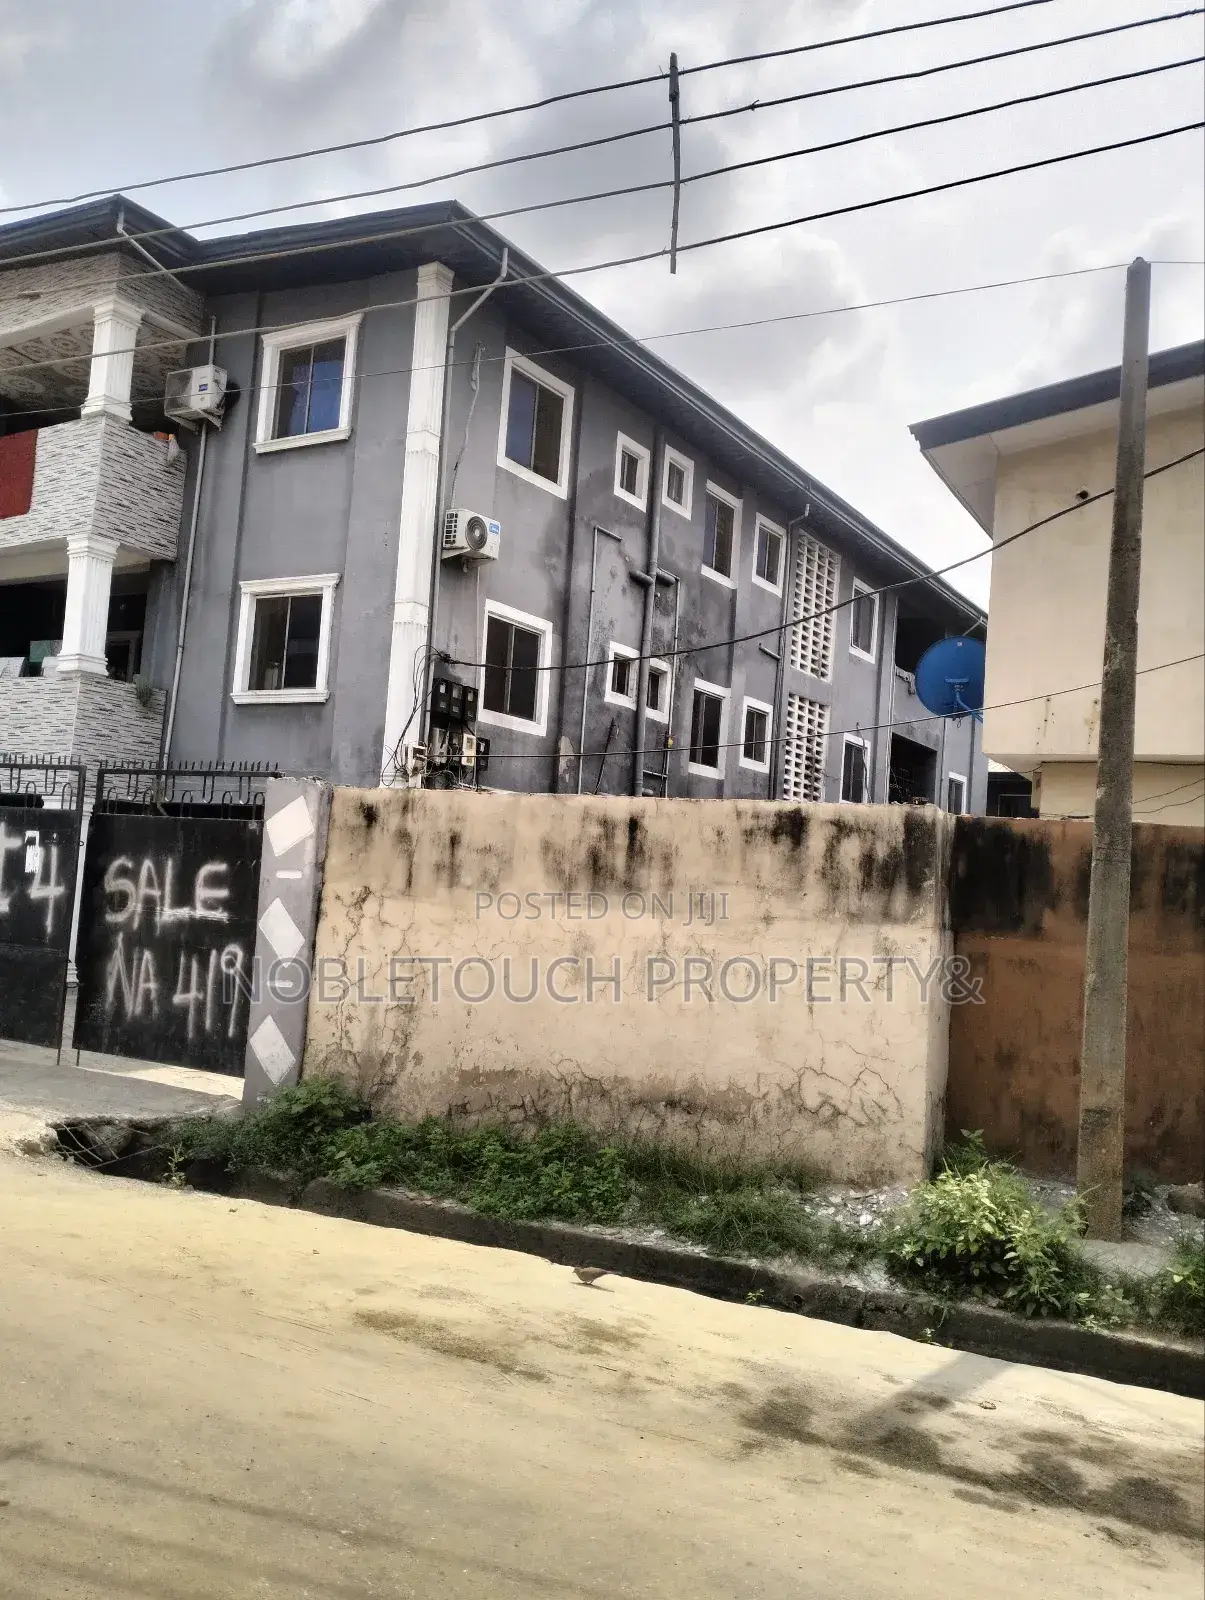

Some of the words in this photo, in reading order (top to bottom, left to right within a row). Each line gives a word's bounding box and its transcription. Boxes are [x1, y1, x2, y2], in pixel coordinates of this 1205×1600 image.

[27, 845, 65, 935] 4
[104, 856, 229, 933] SALE
[105, 933, 159, 1019] NA
[173, 943, 243, 1037] 419
